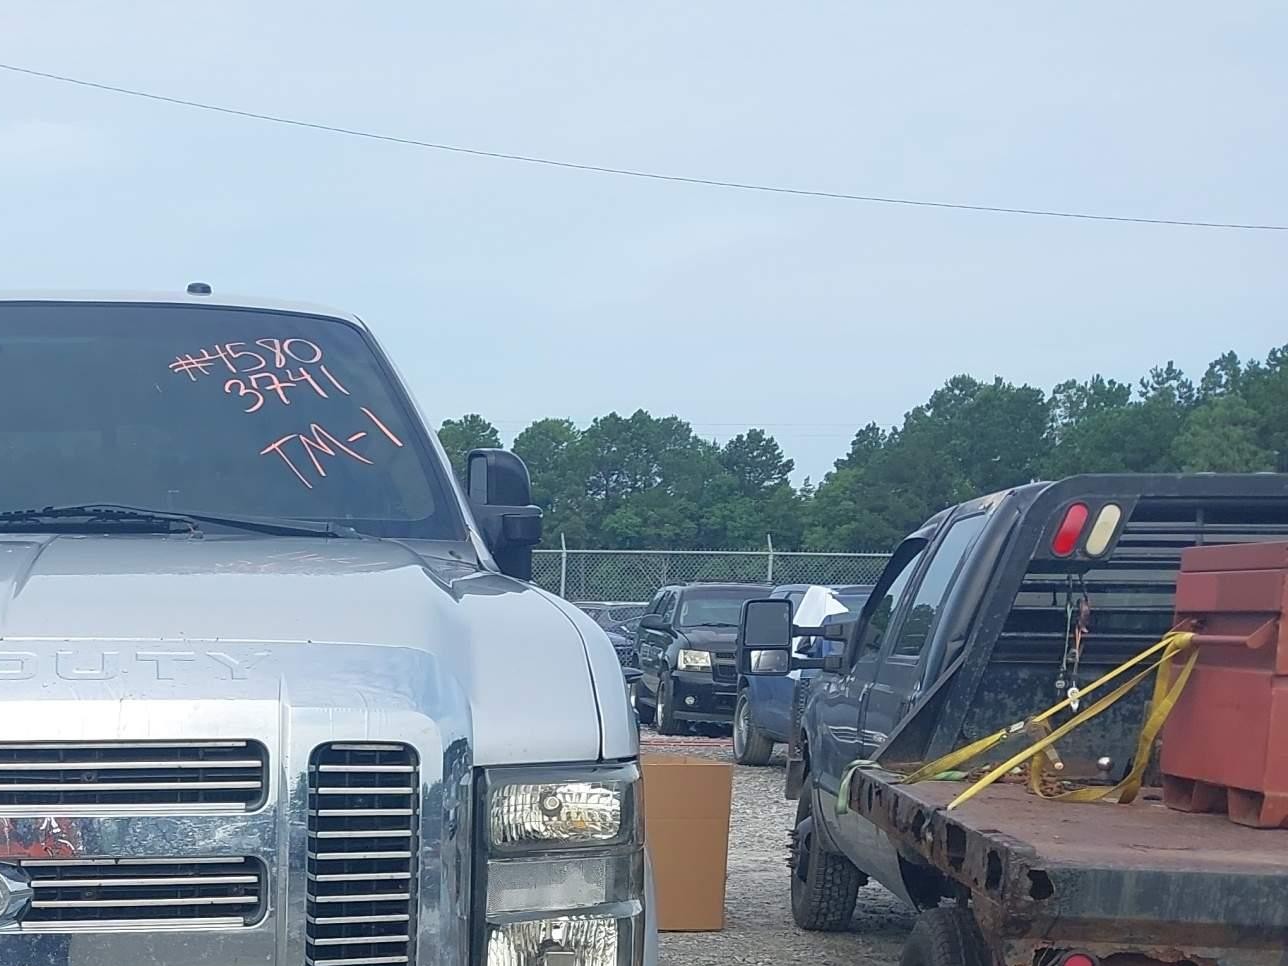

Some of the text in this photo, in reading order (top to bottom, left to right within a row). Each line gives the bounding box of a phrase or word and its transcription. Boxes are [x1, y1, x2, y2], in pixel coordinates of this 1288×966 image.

[168, 338, 323, 381] #4580
[224, 366, 351, 413] 3741
[259, 406, 404, 489] TM-1
